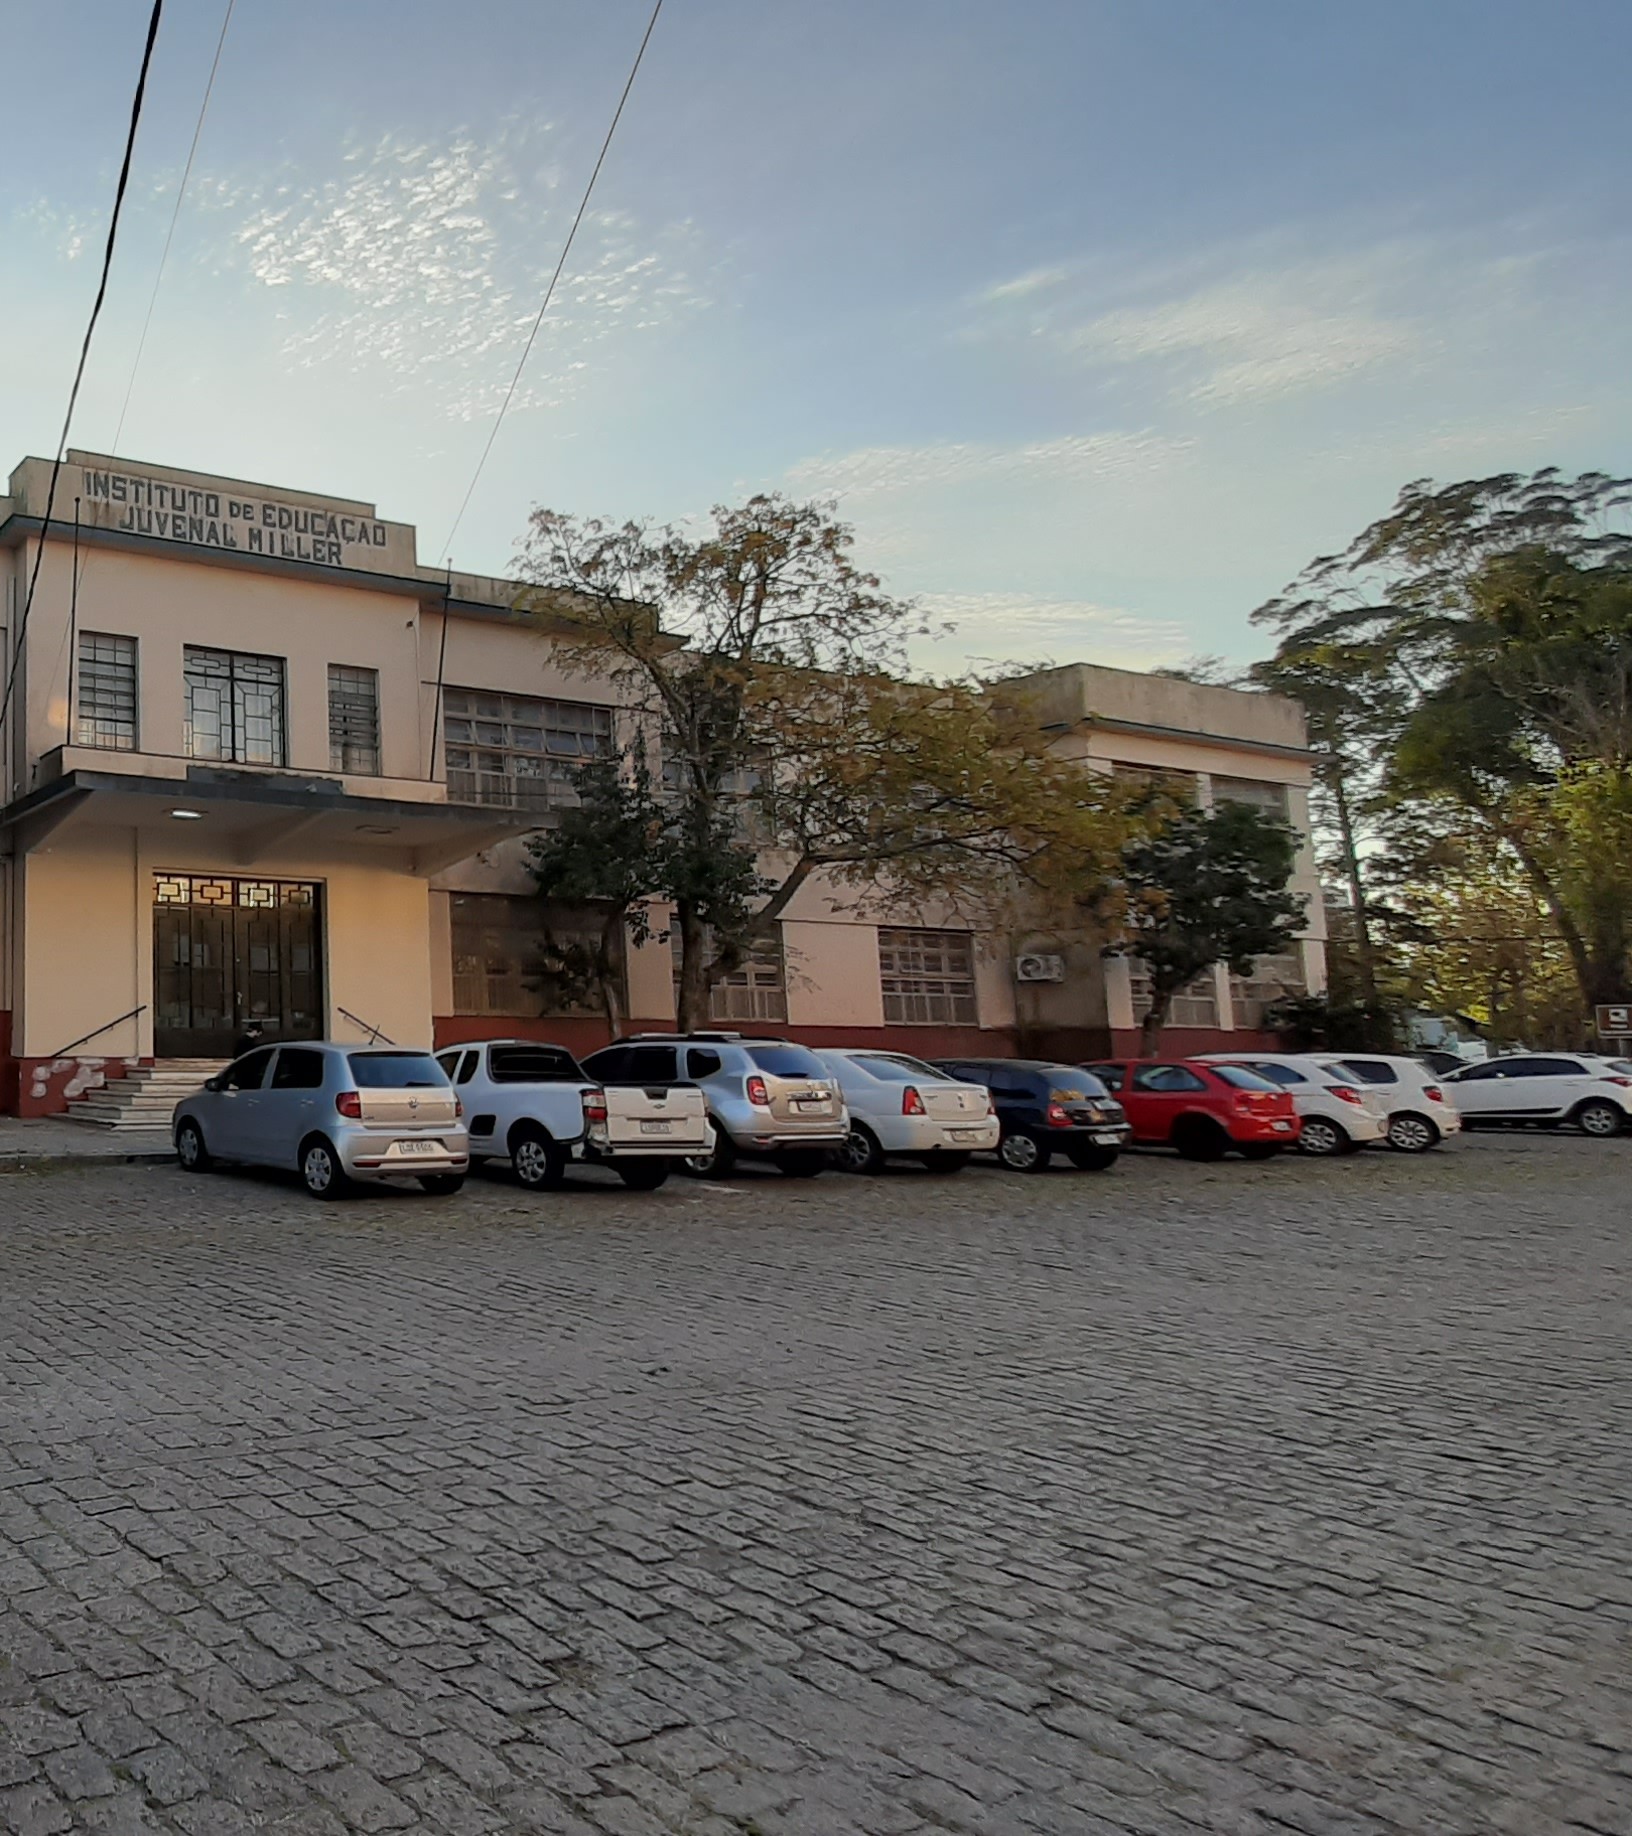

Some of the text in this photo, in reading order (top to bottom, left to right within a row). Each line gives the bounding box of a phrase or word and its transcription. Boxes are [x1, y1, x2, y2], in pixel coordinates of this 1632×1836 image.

[84, 471, 220, 518] INSTITUTO
[229, 500, 255, 521] DE
[119, 505, 342, 565] JUVENAL MILLER
